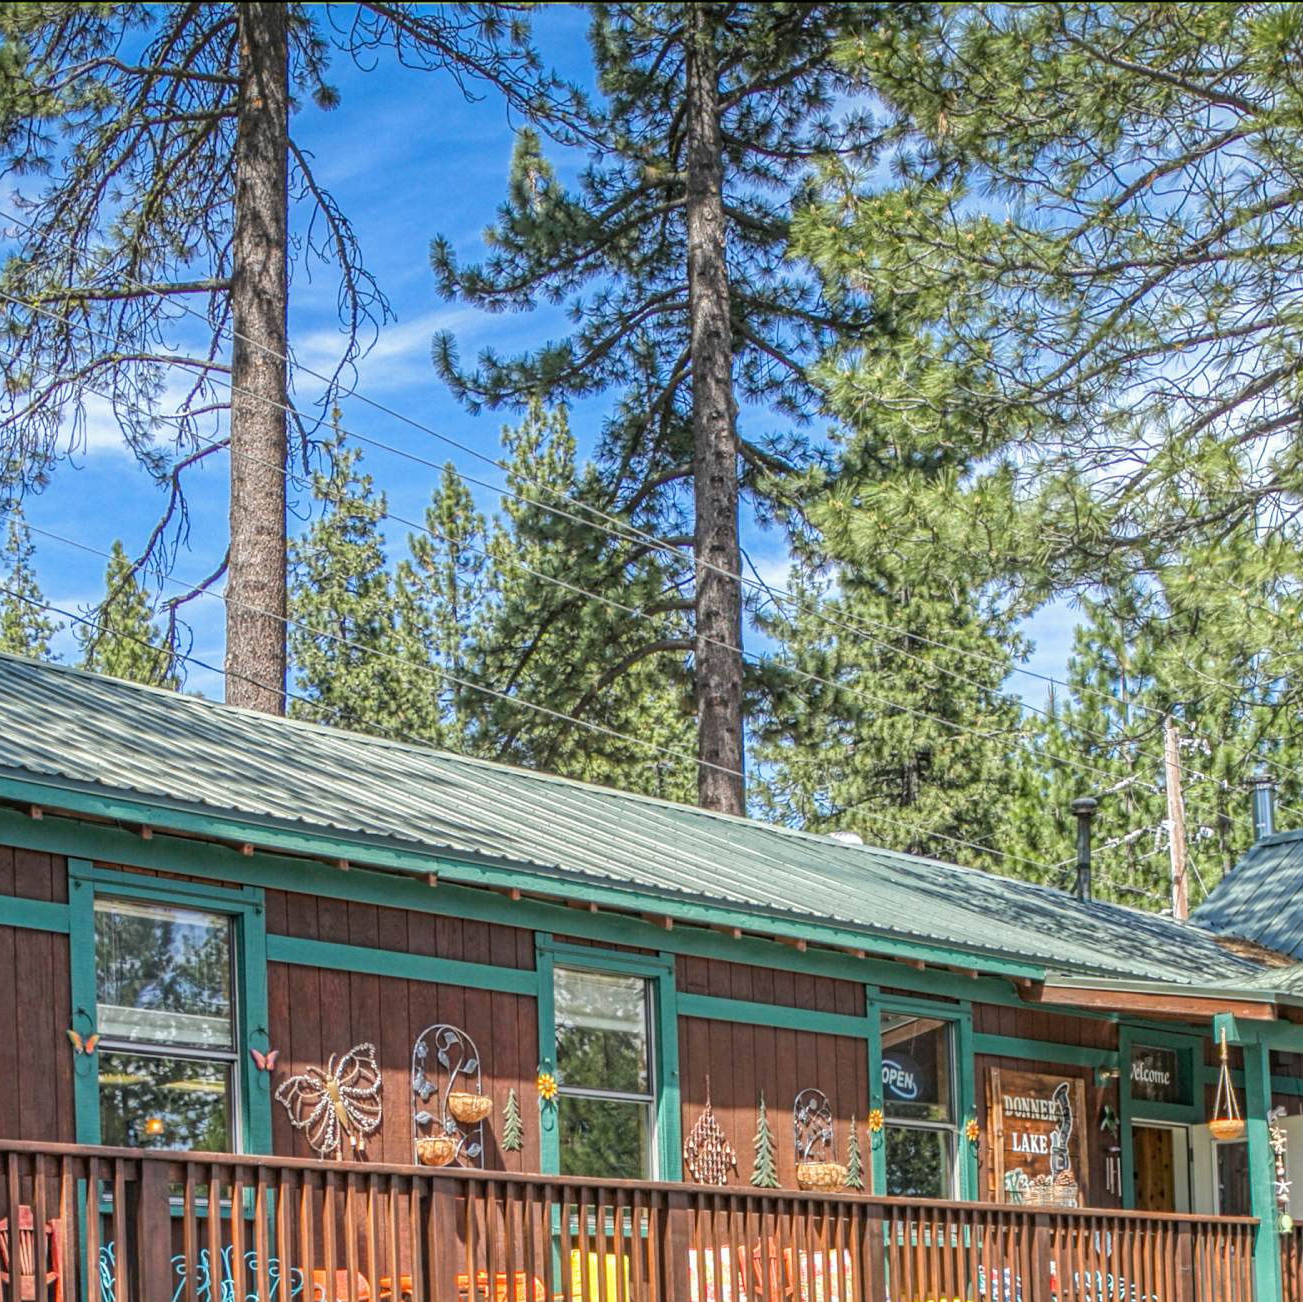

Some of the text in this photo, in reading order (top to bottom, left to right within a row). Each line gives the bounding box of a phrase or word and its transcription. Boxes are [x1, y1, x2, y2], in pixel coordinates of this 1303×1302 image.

[882, 1067, 913, 1090] OPEN
[1004, 1095, 1058, 1122] DONNER
[1012, 1132, 1048, 1154] LAKE
